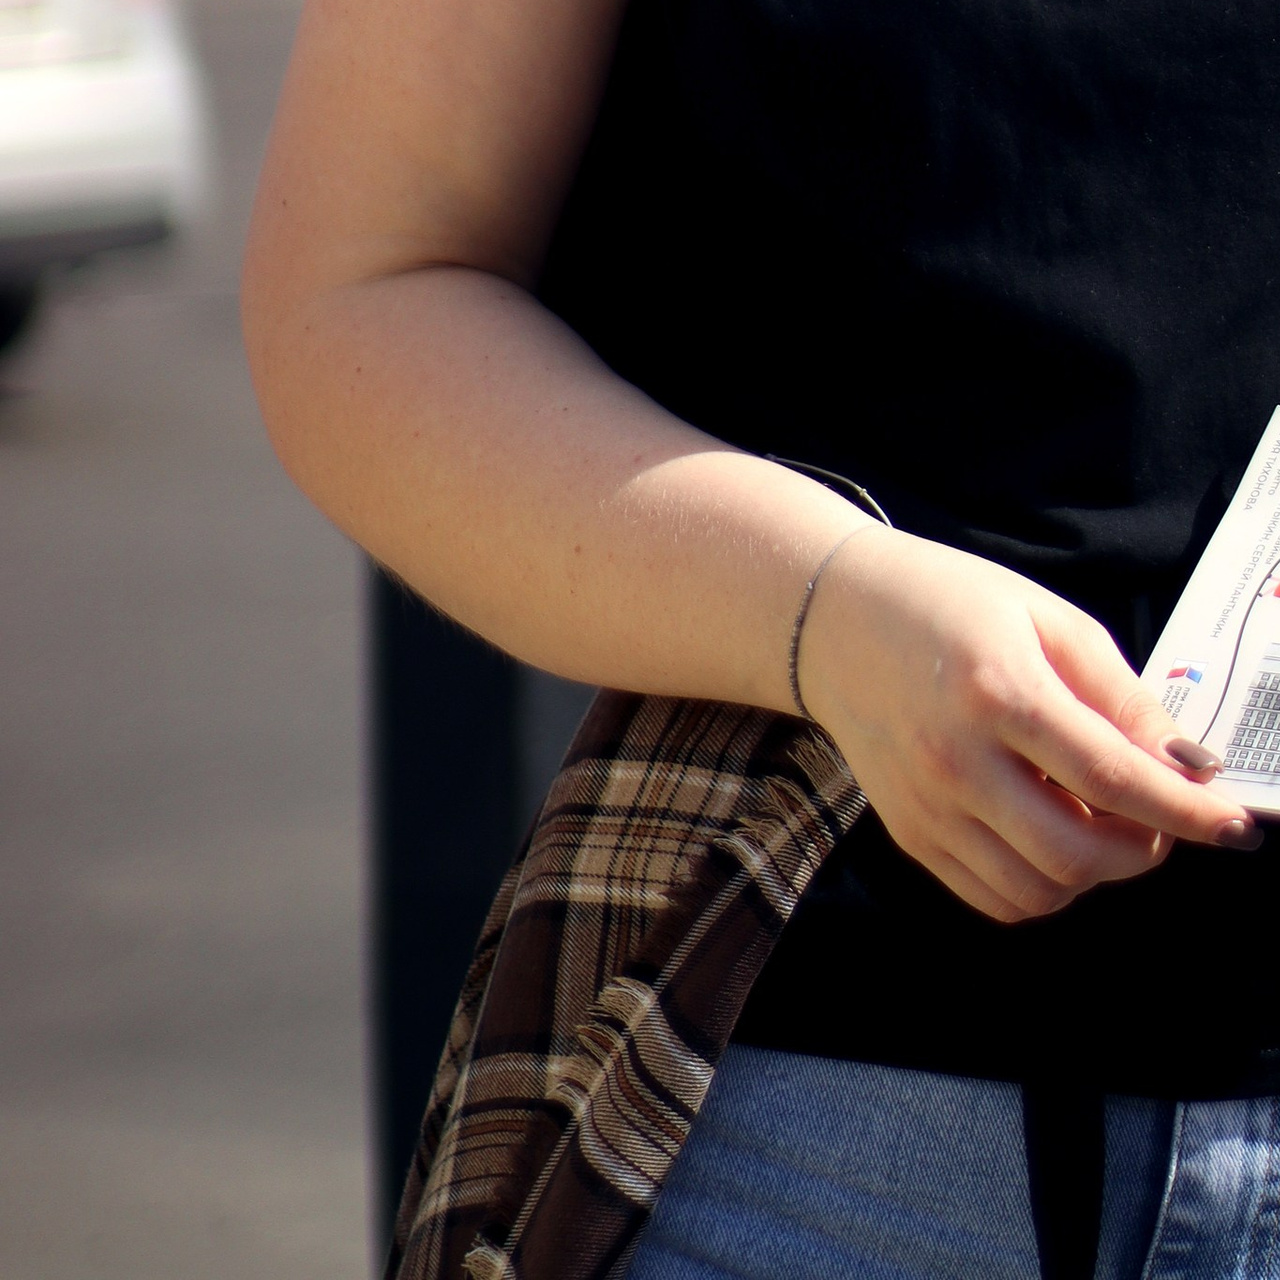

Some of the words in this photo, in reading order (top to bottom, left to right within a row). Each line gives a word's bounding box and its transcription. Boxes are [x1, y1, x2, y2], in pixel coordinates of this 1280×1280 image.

[1243, 456, 1277, 511] ТИХОНОВА
[1242, 544, 1266, 581] СЕРГЕЙ
[1210, 582, 1246, 638] ПАНТЫКИН
